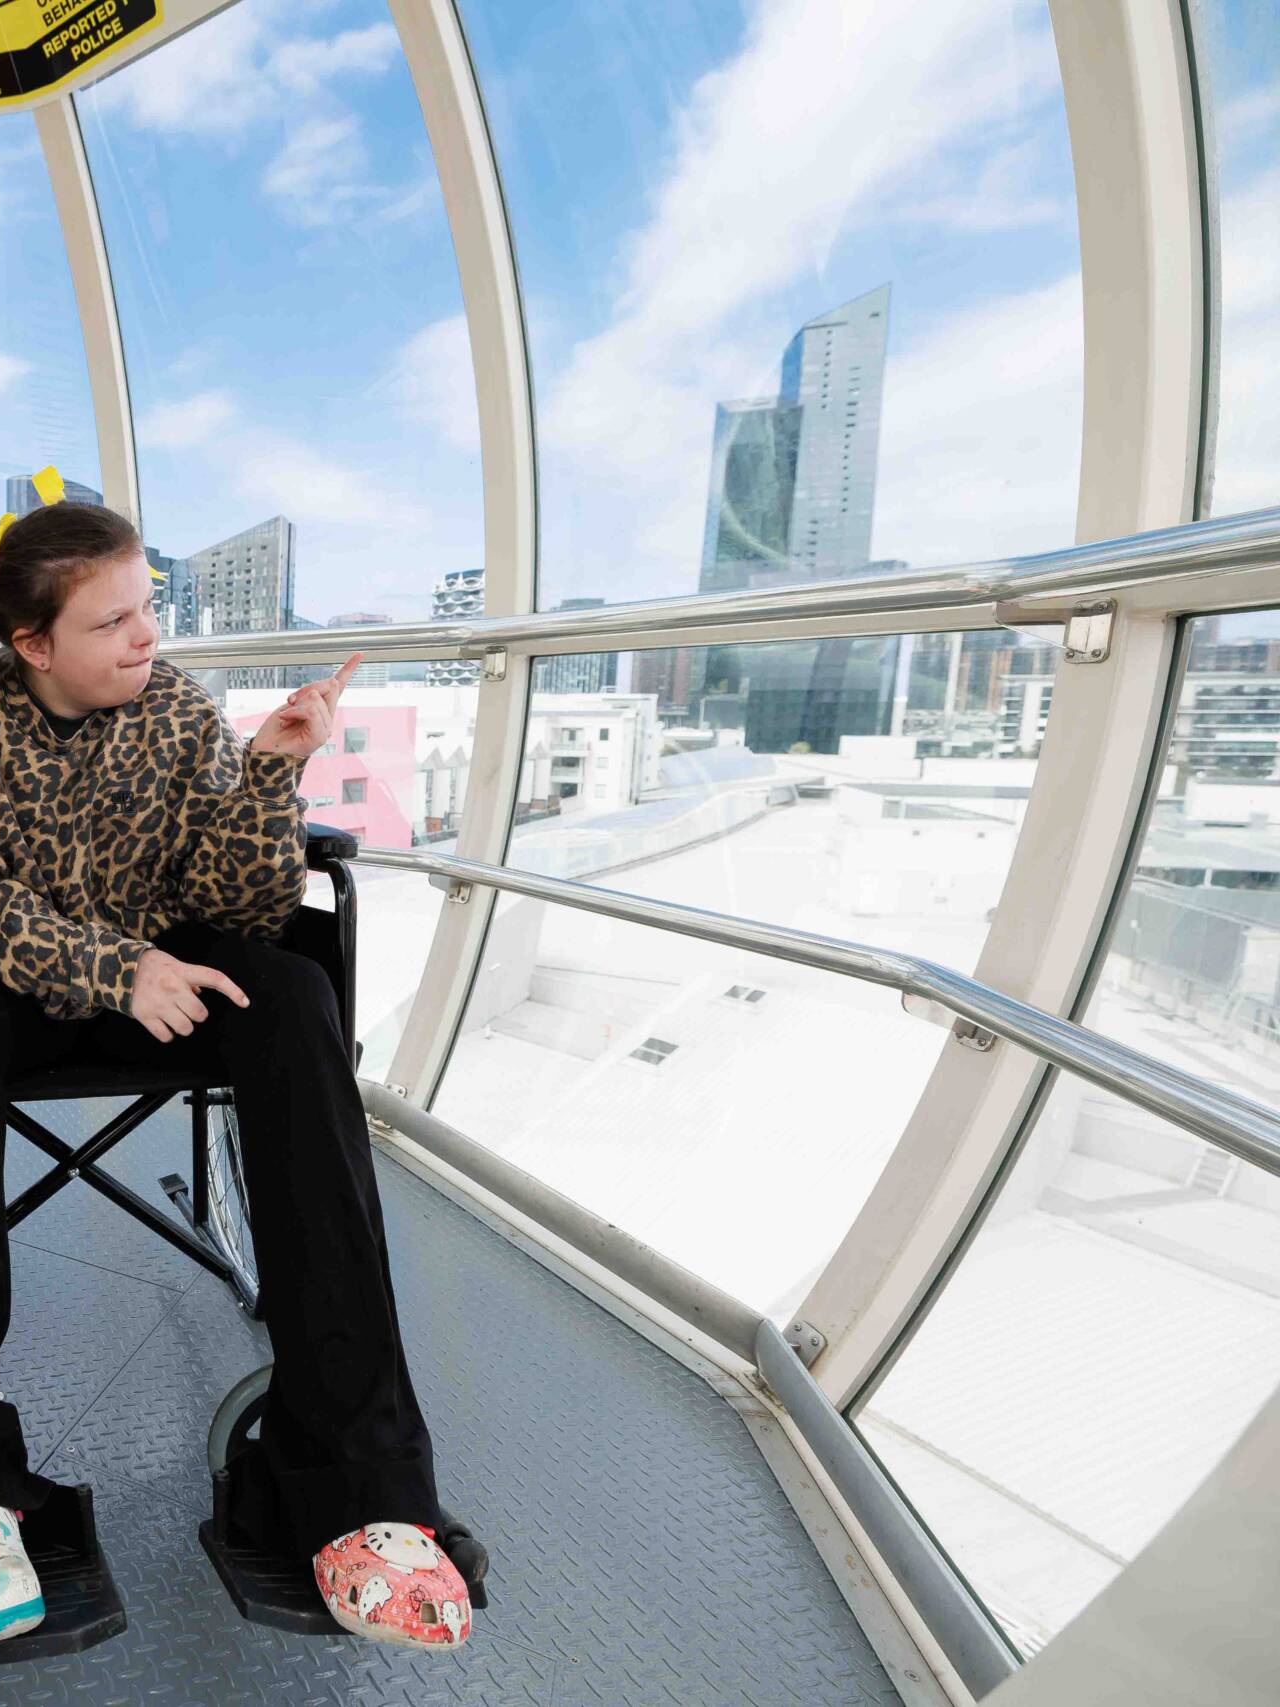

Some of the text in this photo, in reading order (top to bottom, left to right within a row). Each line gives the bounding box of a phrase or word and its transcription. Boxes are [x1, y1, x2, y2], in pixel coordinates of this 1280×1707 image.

[42, 0, 85, 27] BEHA
[42, 0, 117, 58] REPORTED
[70, 17, 124, 61] POLICE
